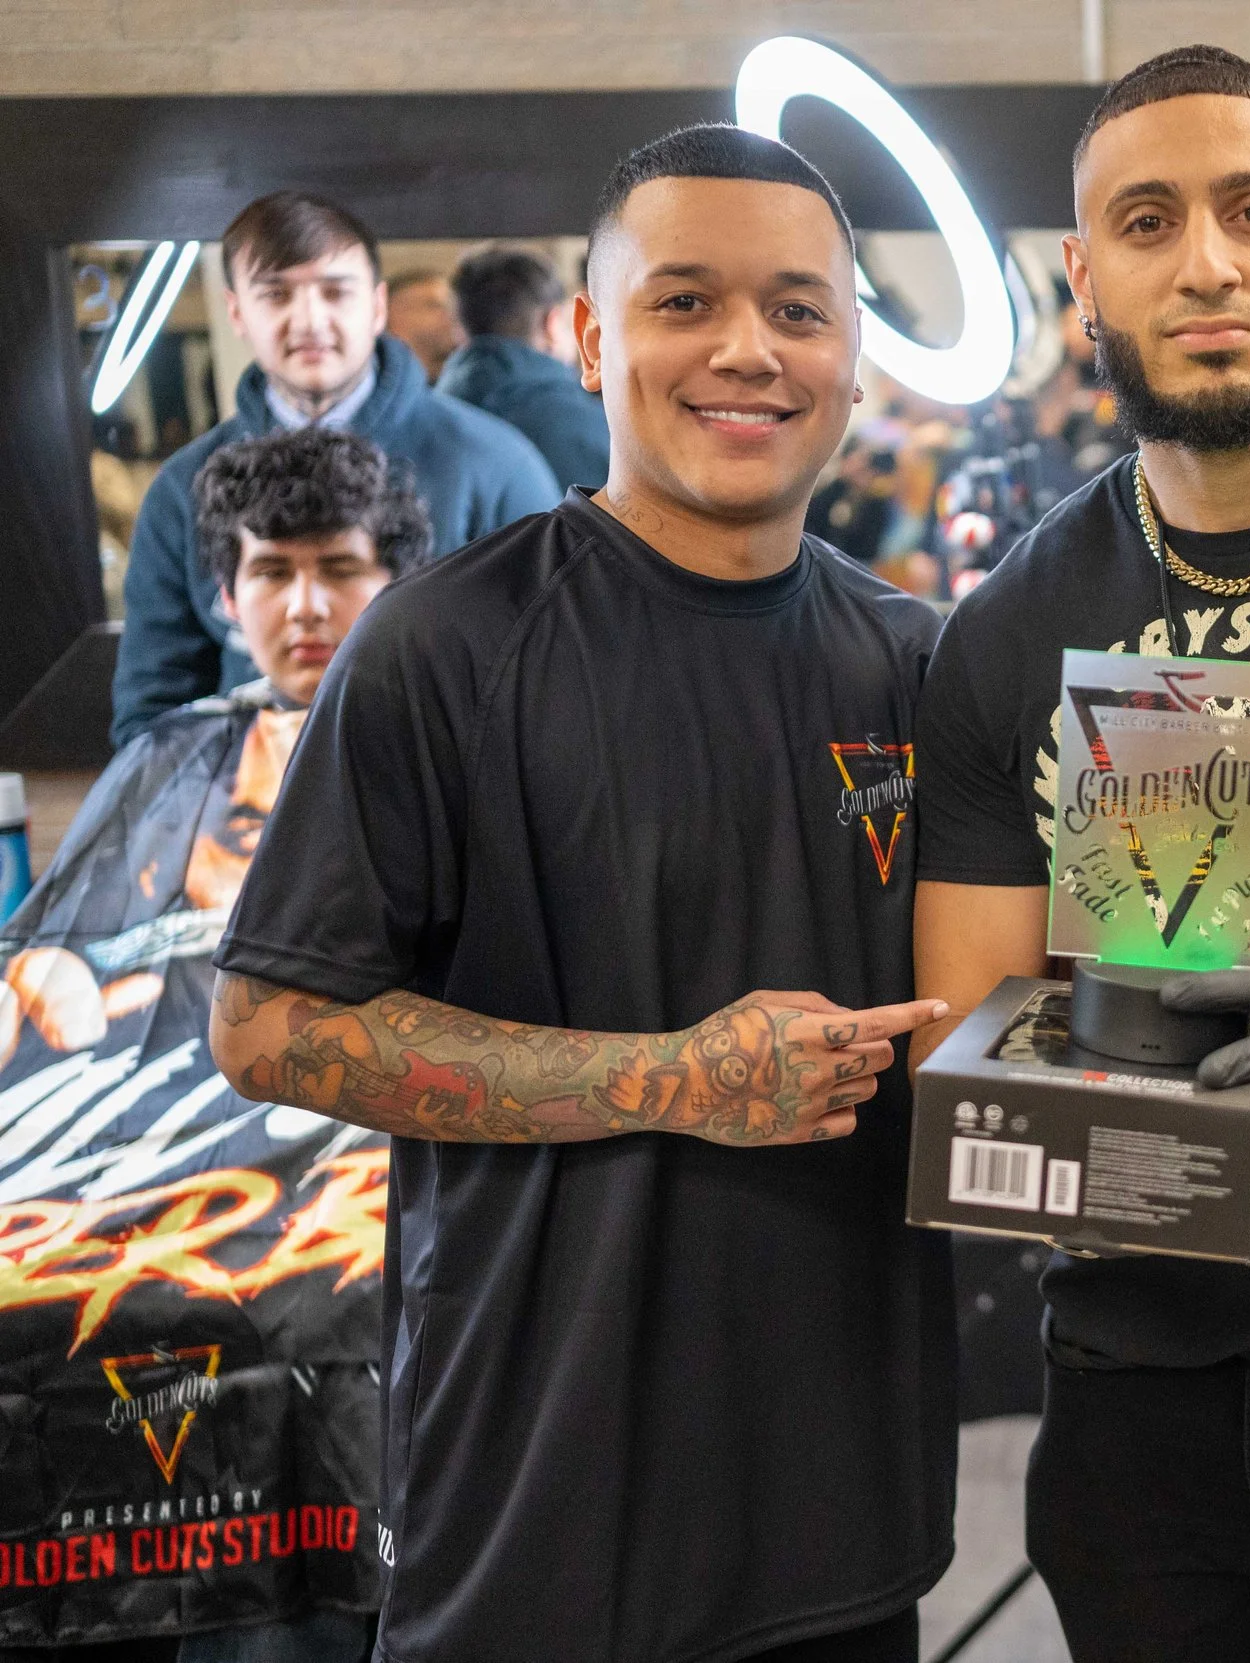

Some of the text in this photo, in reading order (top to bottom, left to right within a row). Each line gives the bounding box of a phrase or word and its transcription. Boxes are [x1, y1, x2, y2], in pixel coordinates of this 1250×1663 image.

[1106, 1073, 1194, 1091] COLLECTION
[131, 1521, 217, 1575] CUTS
[222, 1504, 360, 1567] STUDIO
